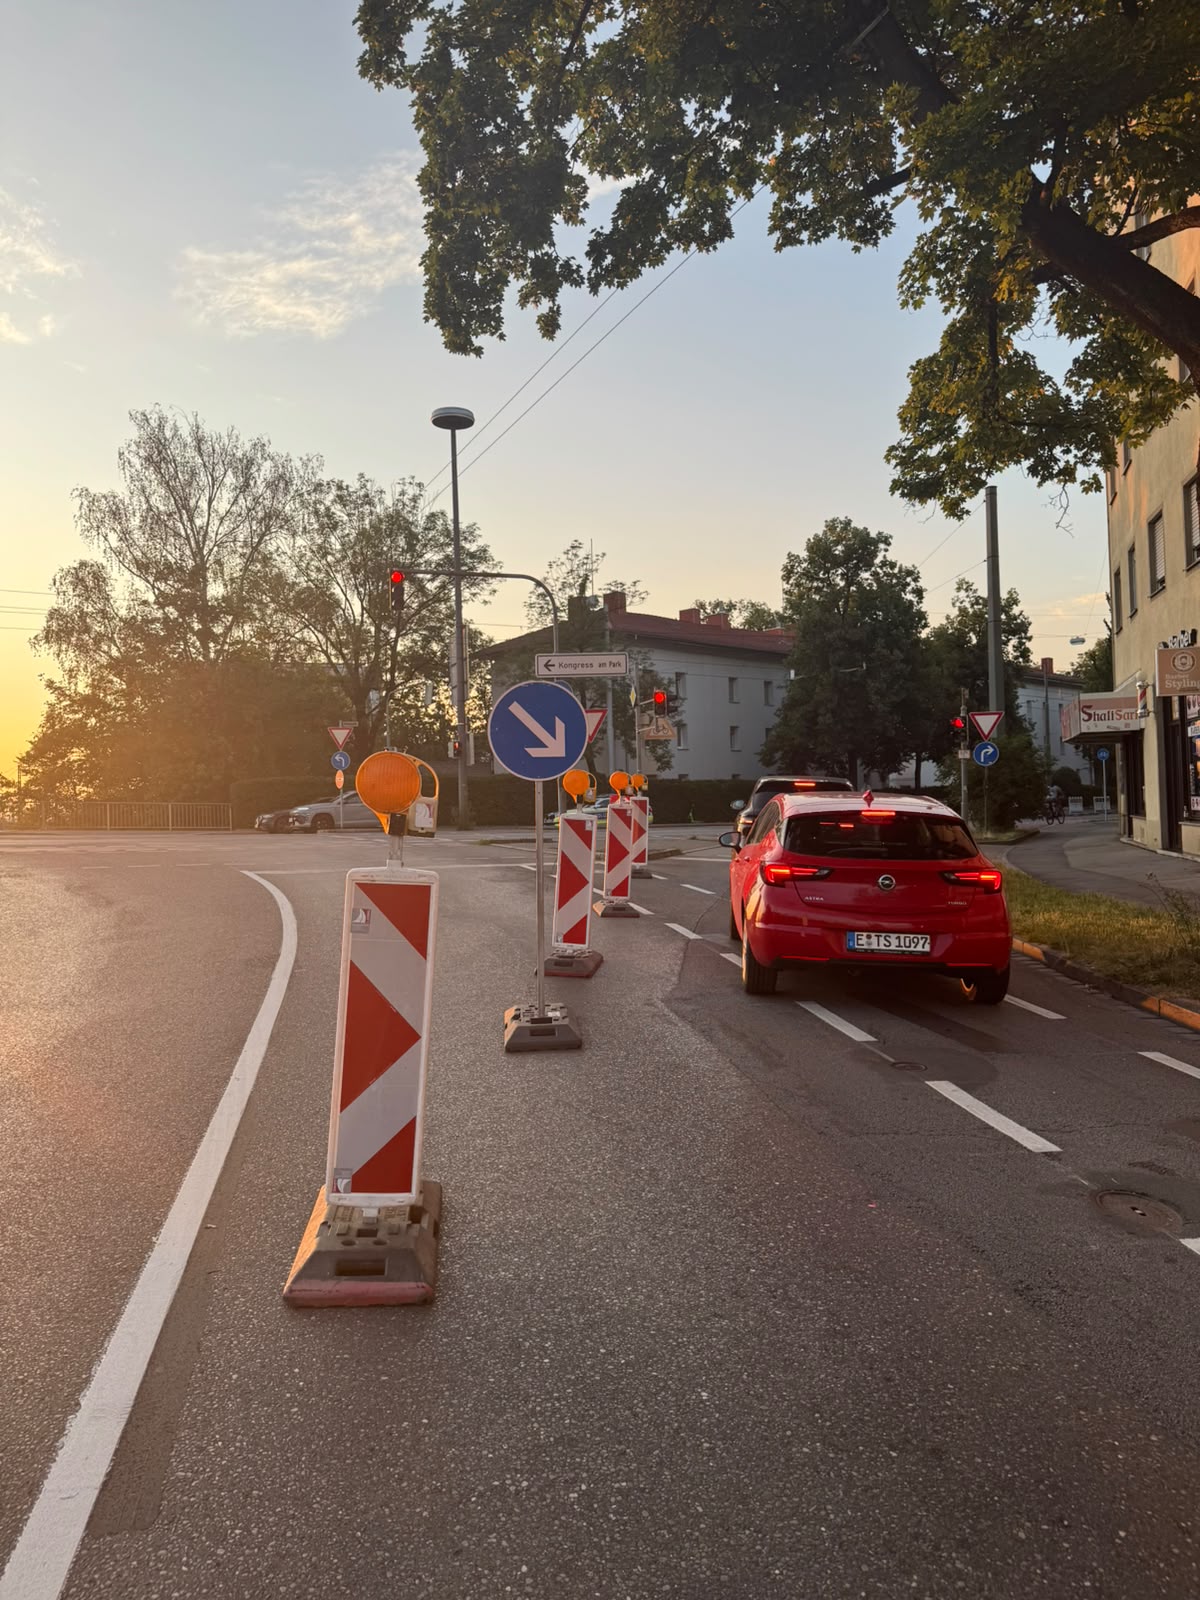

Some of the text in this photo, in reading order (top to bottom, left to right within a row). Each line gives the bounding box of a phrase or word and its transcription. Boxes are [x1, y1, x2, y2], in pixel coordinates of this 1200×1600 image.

[558, 662, 594, 670] Kongress
[856, 934, 929, 949] E TS 1097
